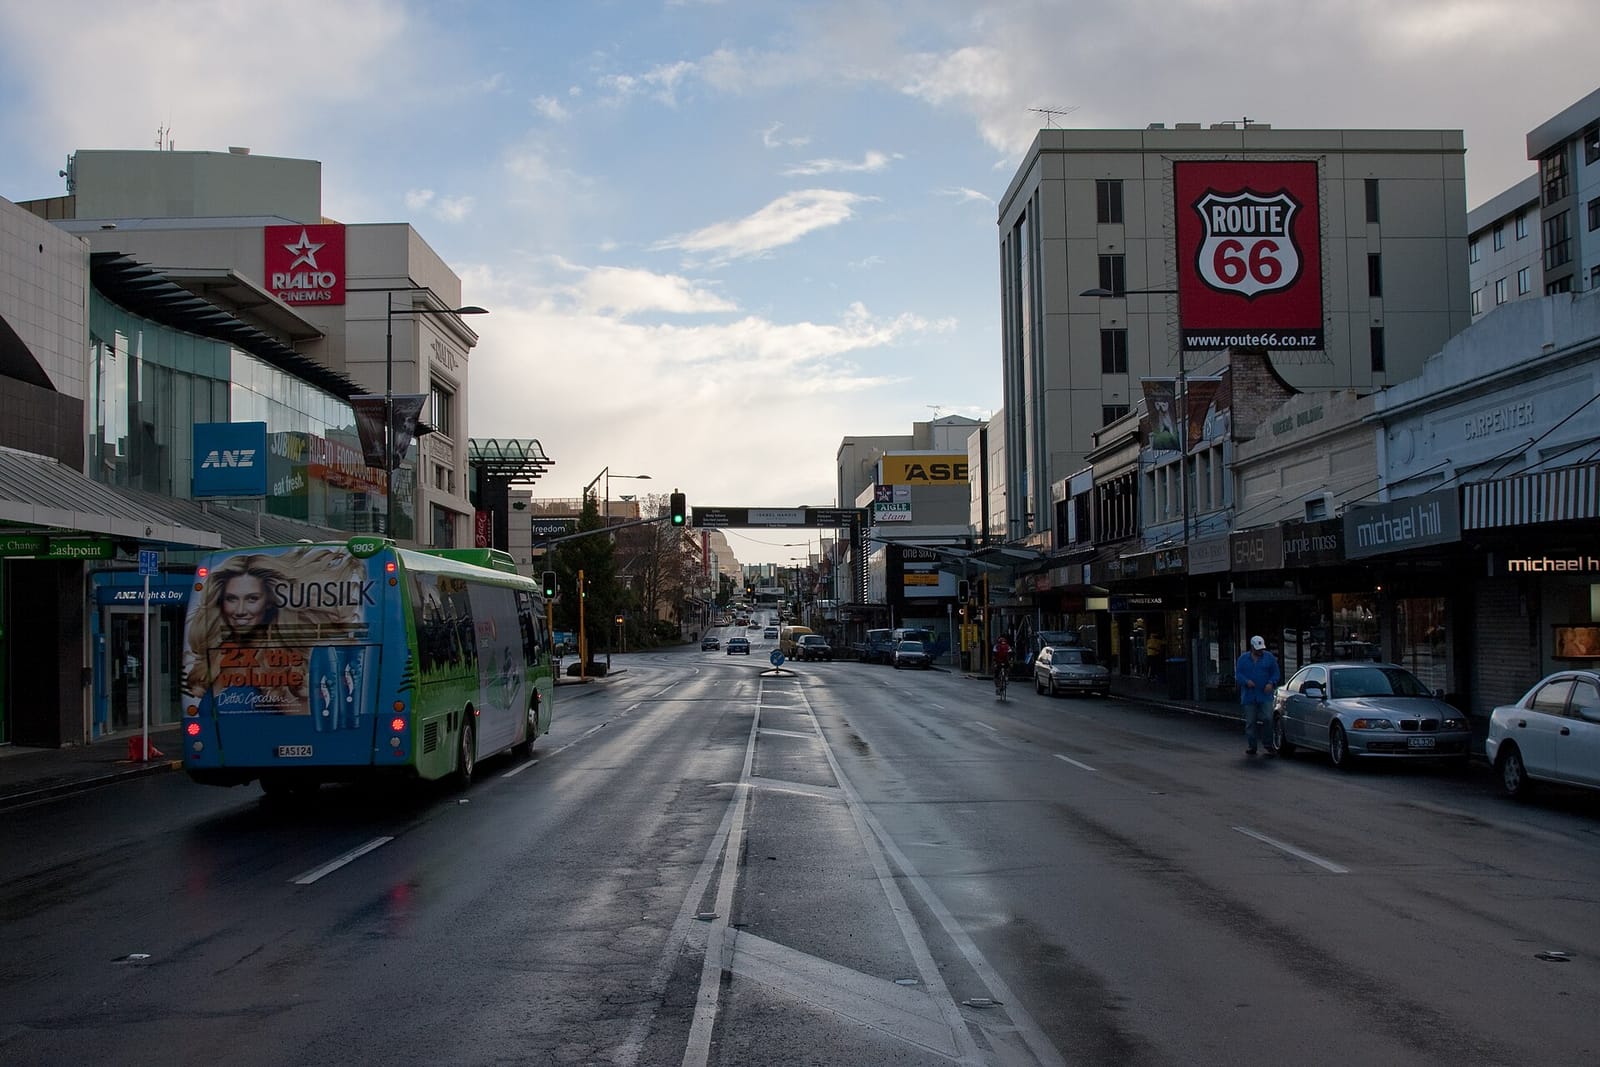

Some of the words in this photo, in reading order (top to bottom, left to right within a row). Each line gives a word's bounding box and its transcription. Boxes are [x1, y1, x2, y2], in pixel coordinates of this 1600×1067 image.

[1212, 205, 1283, 233] ROUTE
[1213, 239, 1283, 285] 66
[272, 271, 336, 289] RIALTO
[278, 290, 332, 301] CINEMAS
[1186, 333, 1317, 347] www.route66.co.nz
[1463, 400, 1535, 441] CARPENTER
[271, 432, 305, 463] SUBWAY
[201, 449, 256, 468] ANZ
[273, 477, 285, 496] eat
[880, 503, 908, 511] AIGLE
[532, 523, 566, 534] freedom
[1357, 507, 1416, 547] michael
[1419, 501, 1442, 537] hill
[49, 543, 101, 558] Cashpoint
[351, 543, 375, 553] 1903
[1234, 537, 1264, 563] GRAB
[1283, 537, 1310, 562] purple
[1312, 533, 1337, 551] moss
[1508, 556, 1583, 572] michael
[113, 591, 137, 600] ANZ
[138, 591, 159, 601] Nght
[160, 591, 167, 600] &
[168, 590, 184, 601] Day
[266, 649, 304, 667] the
[217, 668, 304, 689] volume
